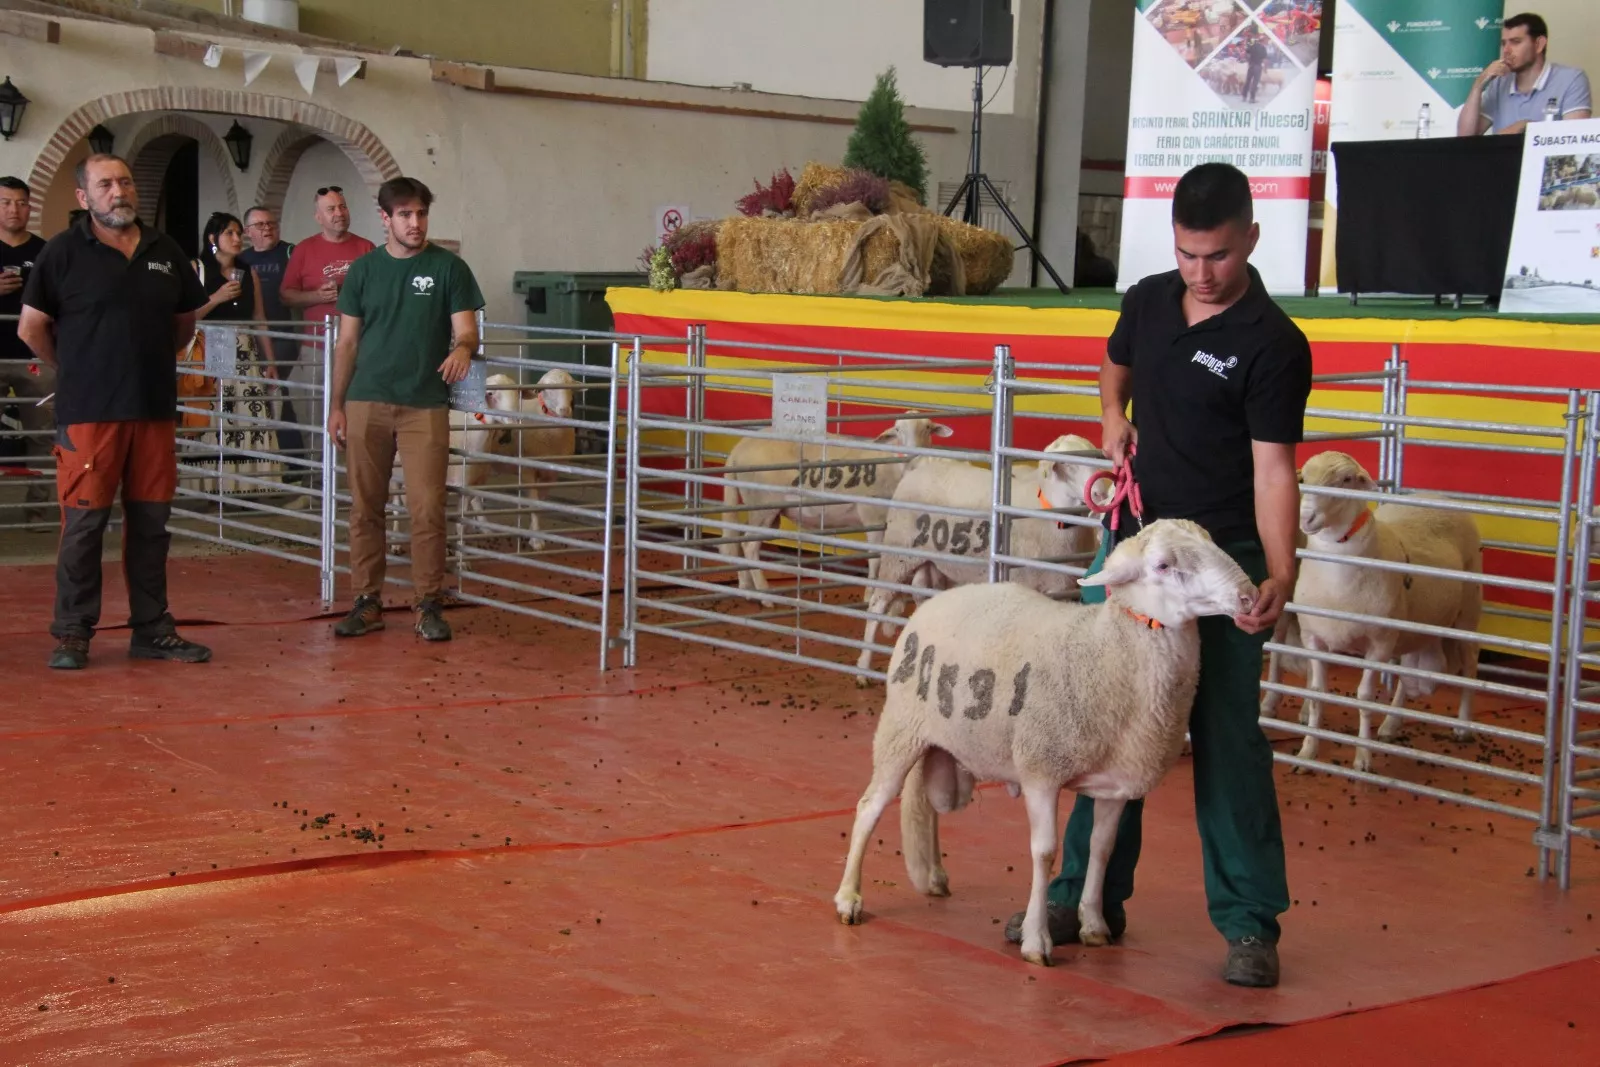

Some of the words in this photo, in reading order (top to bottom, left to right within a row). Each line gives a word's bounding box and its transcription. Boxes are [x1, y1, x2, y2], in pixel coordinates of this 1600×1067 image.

[1165, 116, 1189, 128] FERIAL
[1192, 107, 1251, 128] SARIÑENA
[1255, 108, 1309, 131] (Huesca)
[1156, 136, 1180, 149] FERIA
[1183, 136, 1201, 149] CON
[1203, 133, 1249, 149] CARÁCTER
[1251, 136, 1280, 149] ANUAL
[1134, 154, 1164, 167] TERCER
[1166, 154, 1180, 167] FIN
[1183, 154, 1194, 167] DE
[1235, 154, 1246, 167] DE
[1248, 153, 1303, 167] SEPTIEMBRE
[1191, 350, 1226, 373] pastores
[912, 513, 993, 555] 2053
